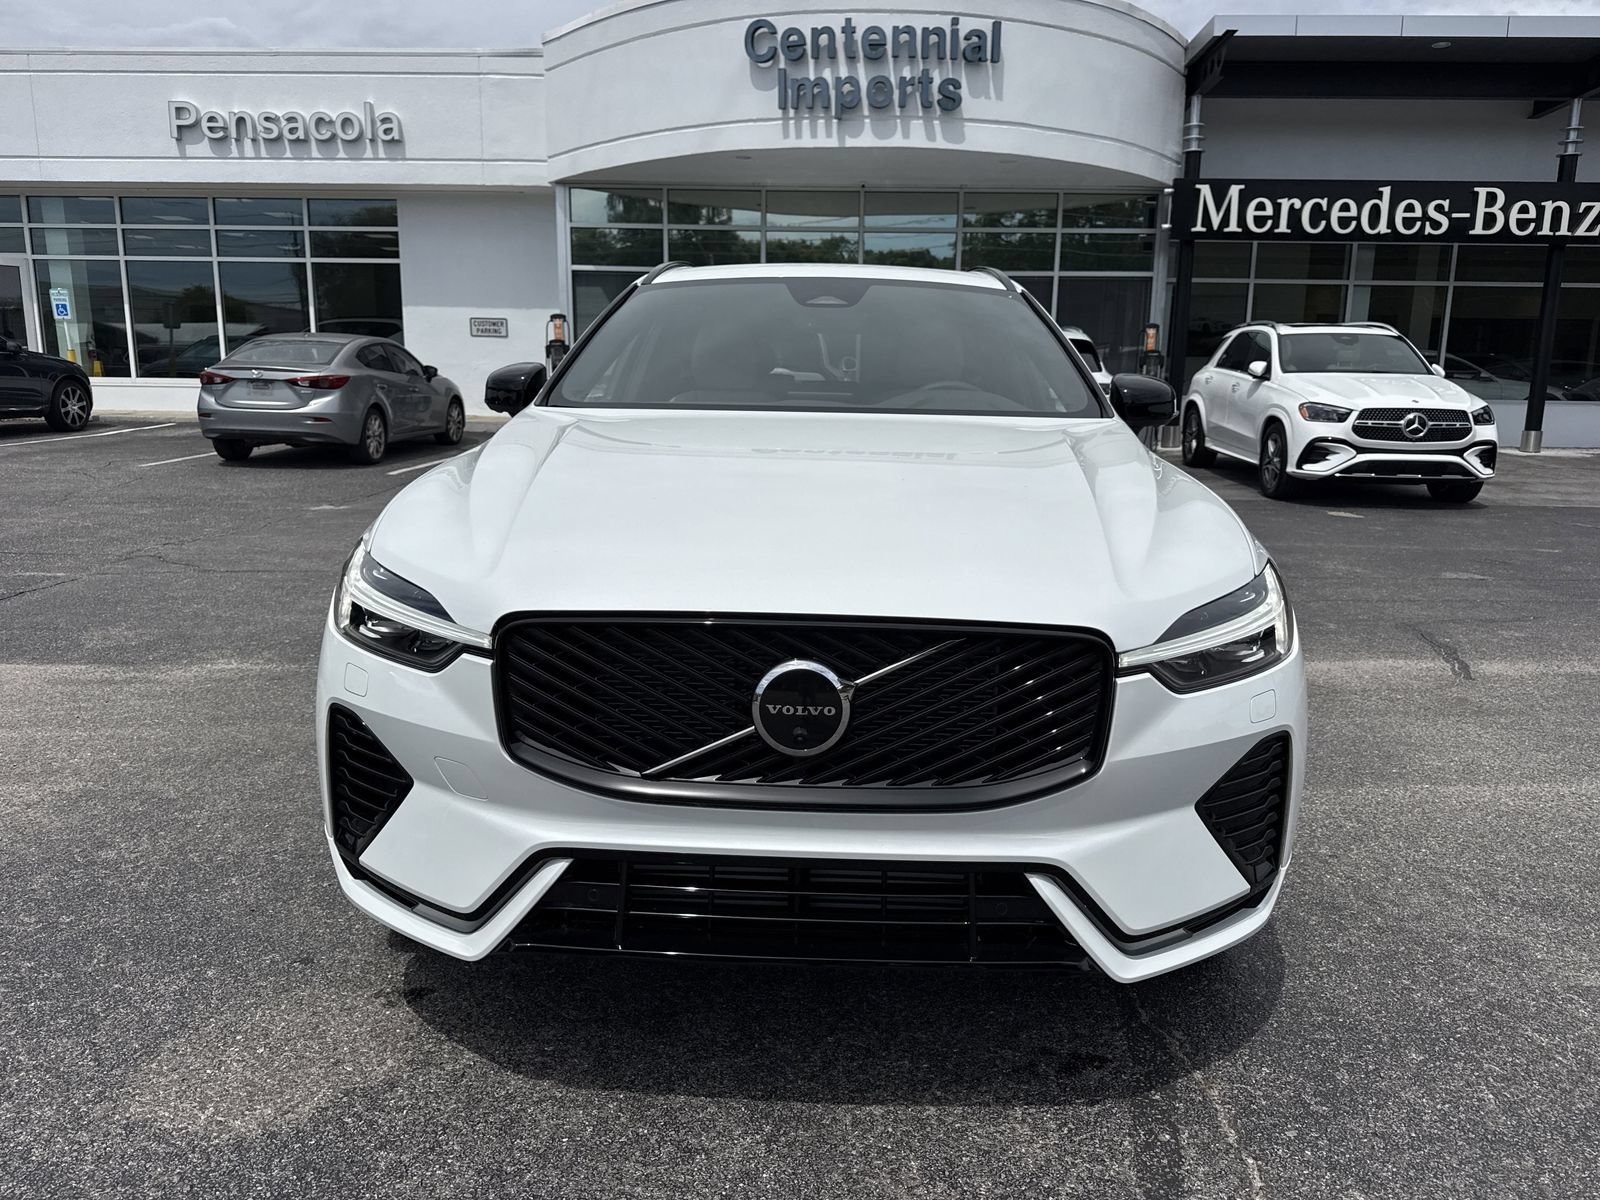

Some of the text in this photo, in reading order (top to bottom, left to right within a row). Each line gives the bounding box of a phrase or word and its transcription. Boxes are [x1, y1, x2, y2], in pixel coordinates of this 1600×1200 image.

[745, 17, 1001, 64] Centennial
[778, 68, 962, 120] Imports
[168, 100, 402, 142] Pensacola
[1191, 184, 1600, 237] Mercedes-Benz
[473, 320, 504, 328] CUSTOMER
[476, 327, 502, 335] PARKING
[766, 704, 836, 716] VOLVO
